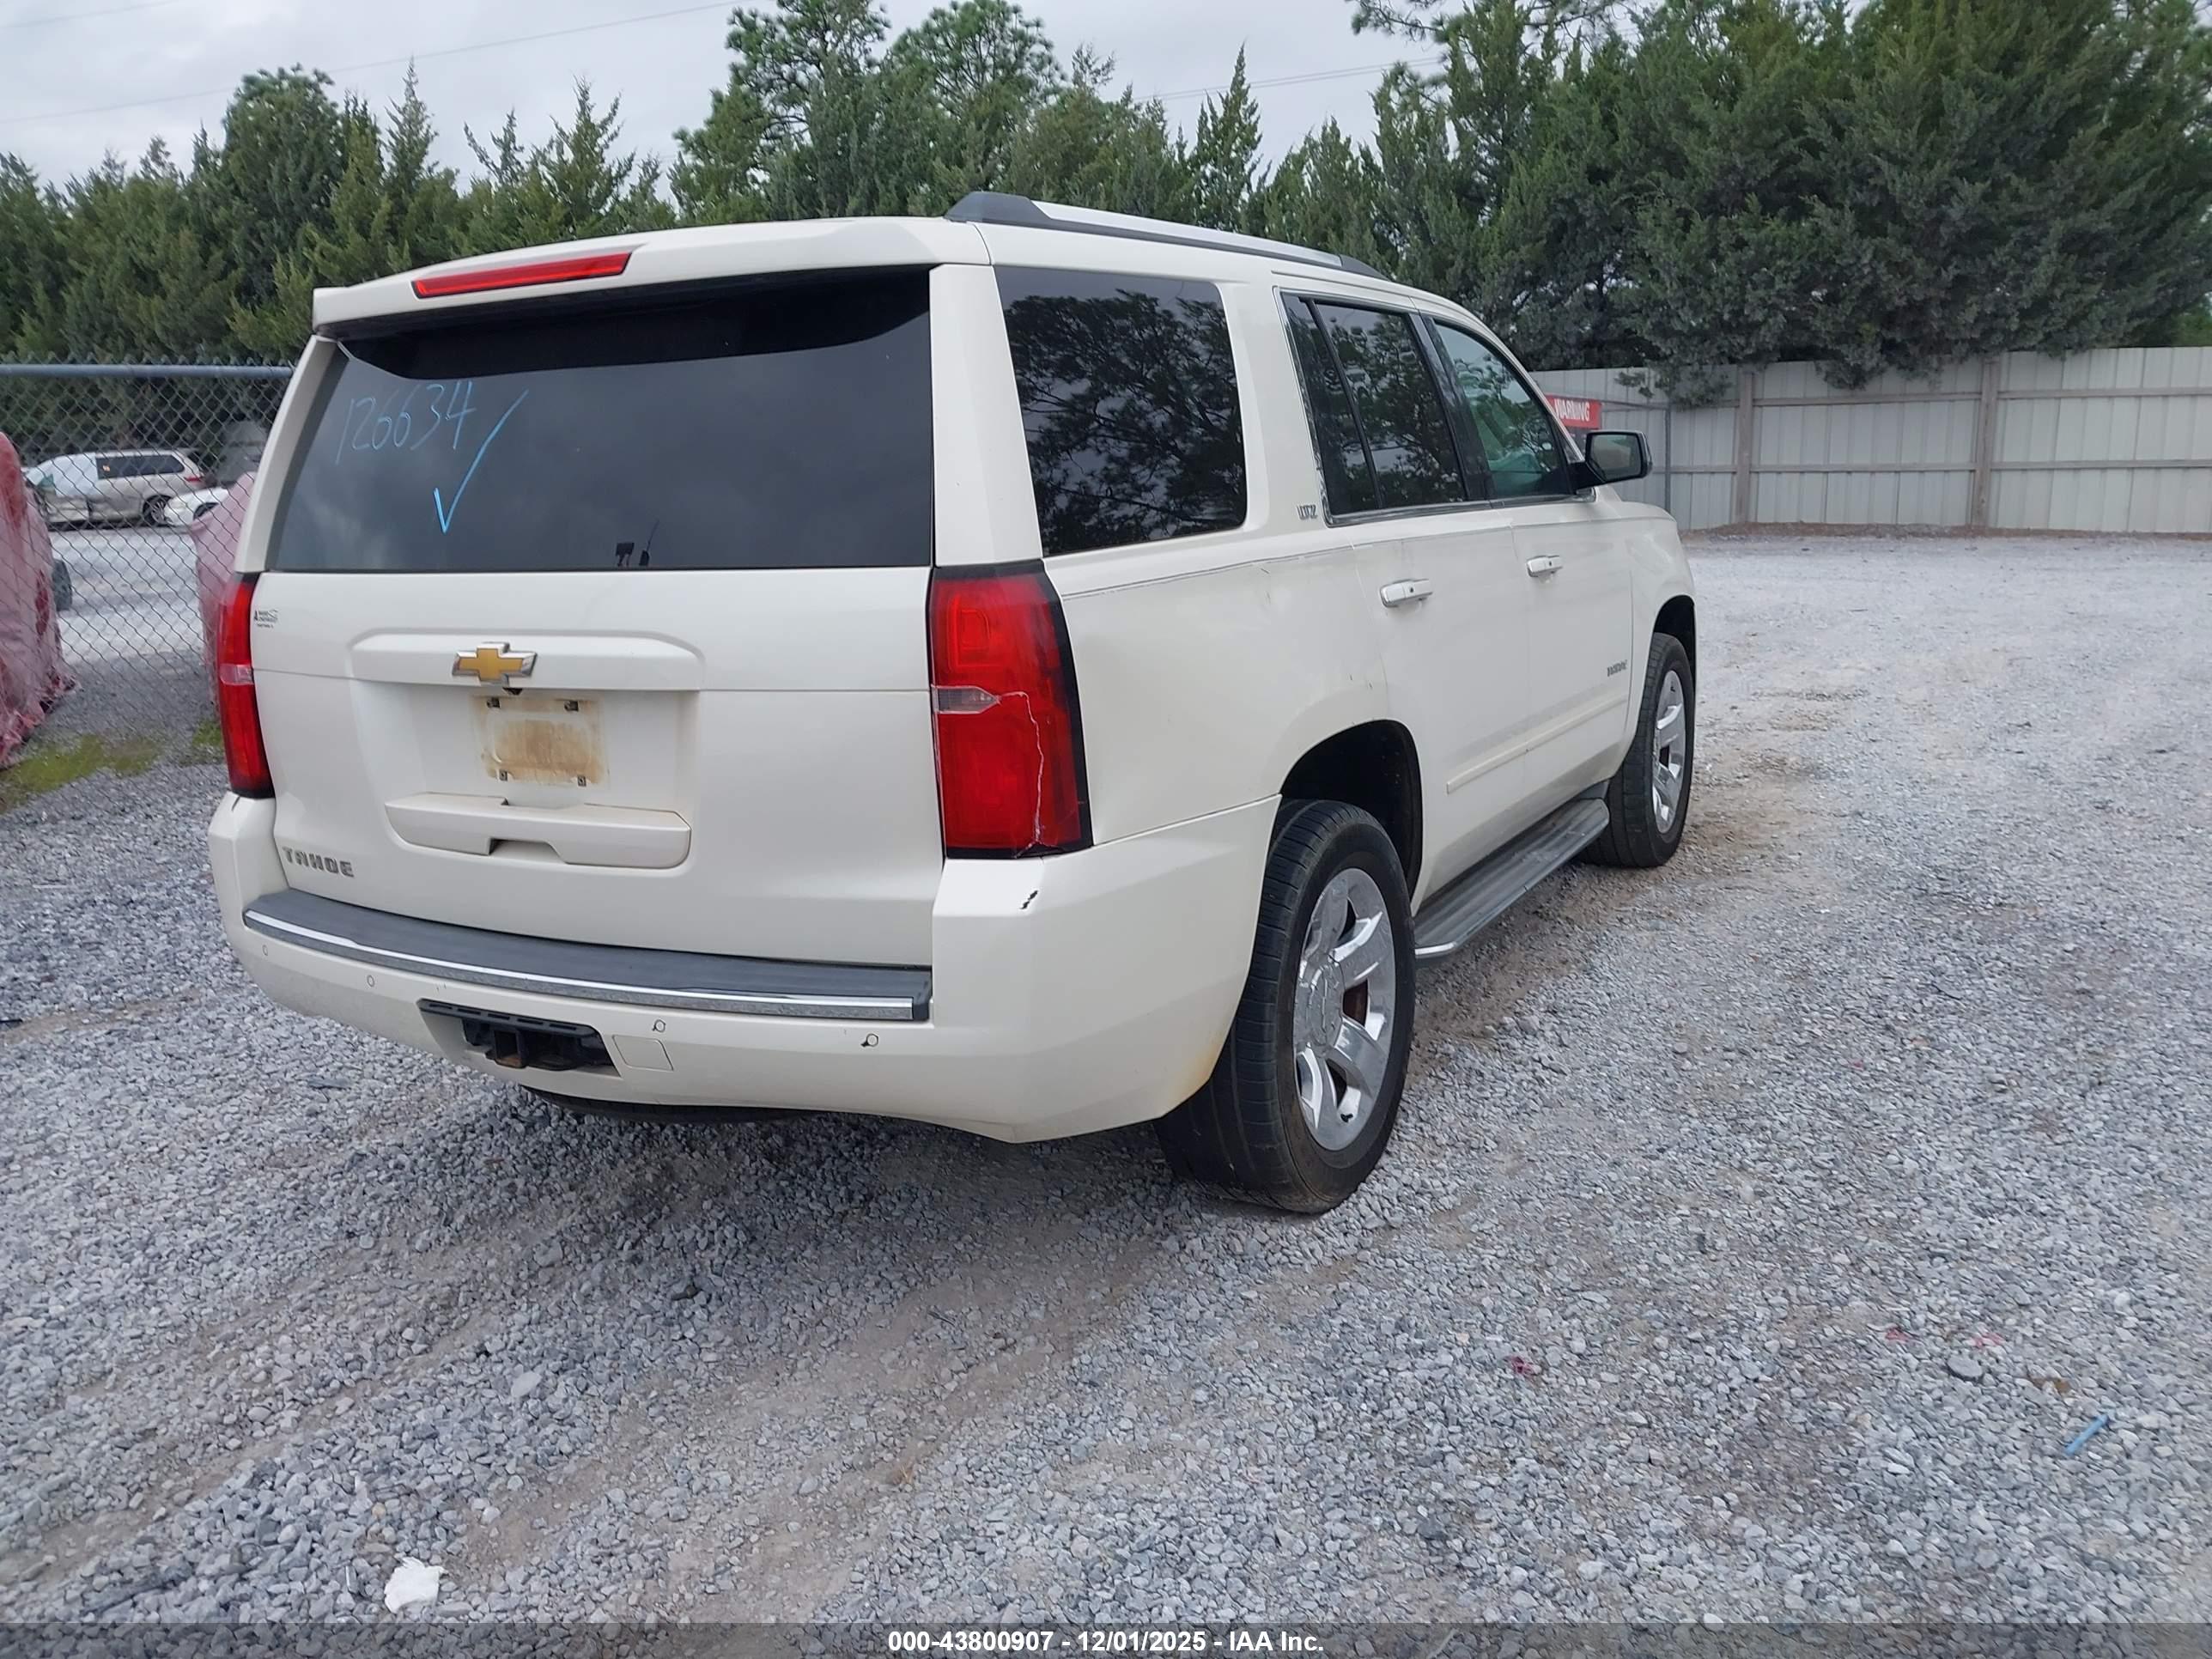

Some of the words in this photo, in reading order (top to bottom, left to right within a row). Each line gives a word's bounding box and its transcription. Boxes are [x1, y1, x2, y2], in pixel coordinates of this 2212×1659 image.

[336, 380, 477, 465] 126634
[1553, 398, 1590, 422] WARNING
[282, 846, 355, 878] TAHOE
